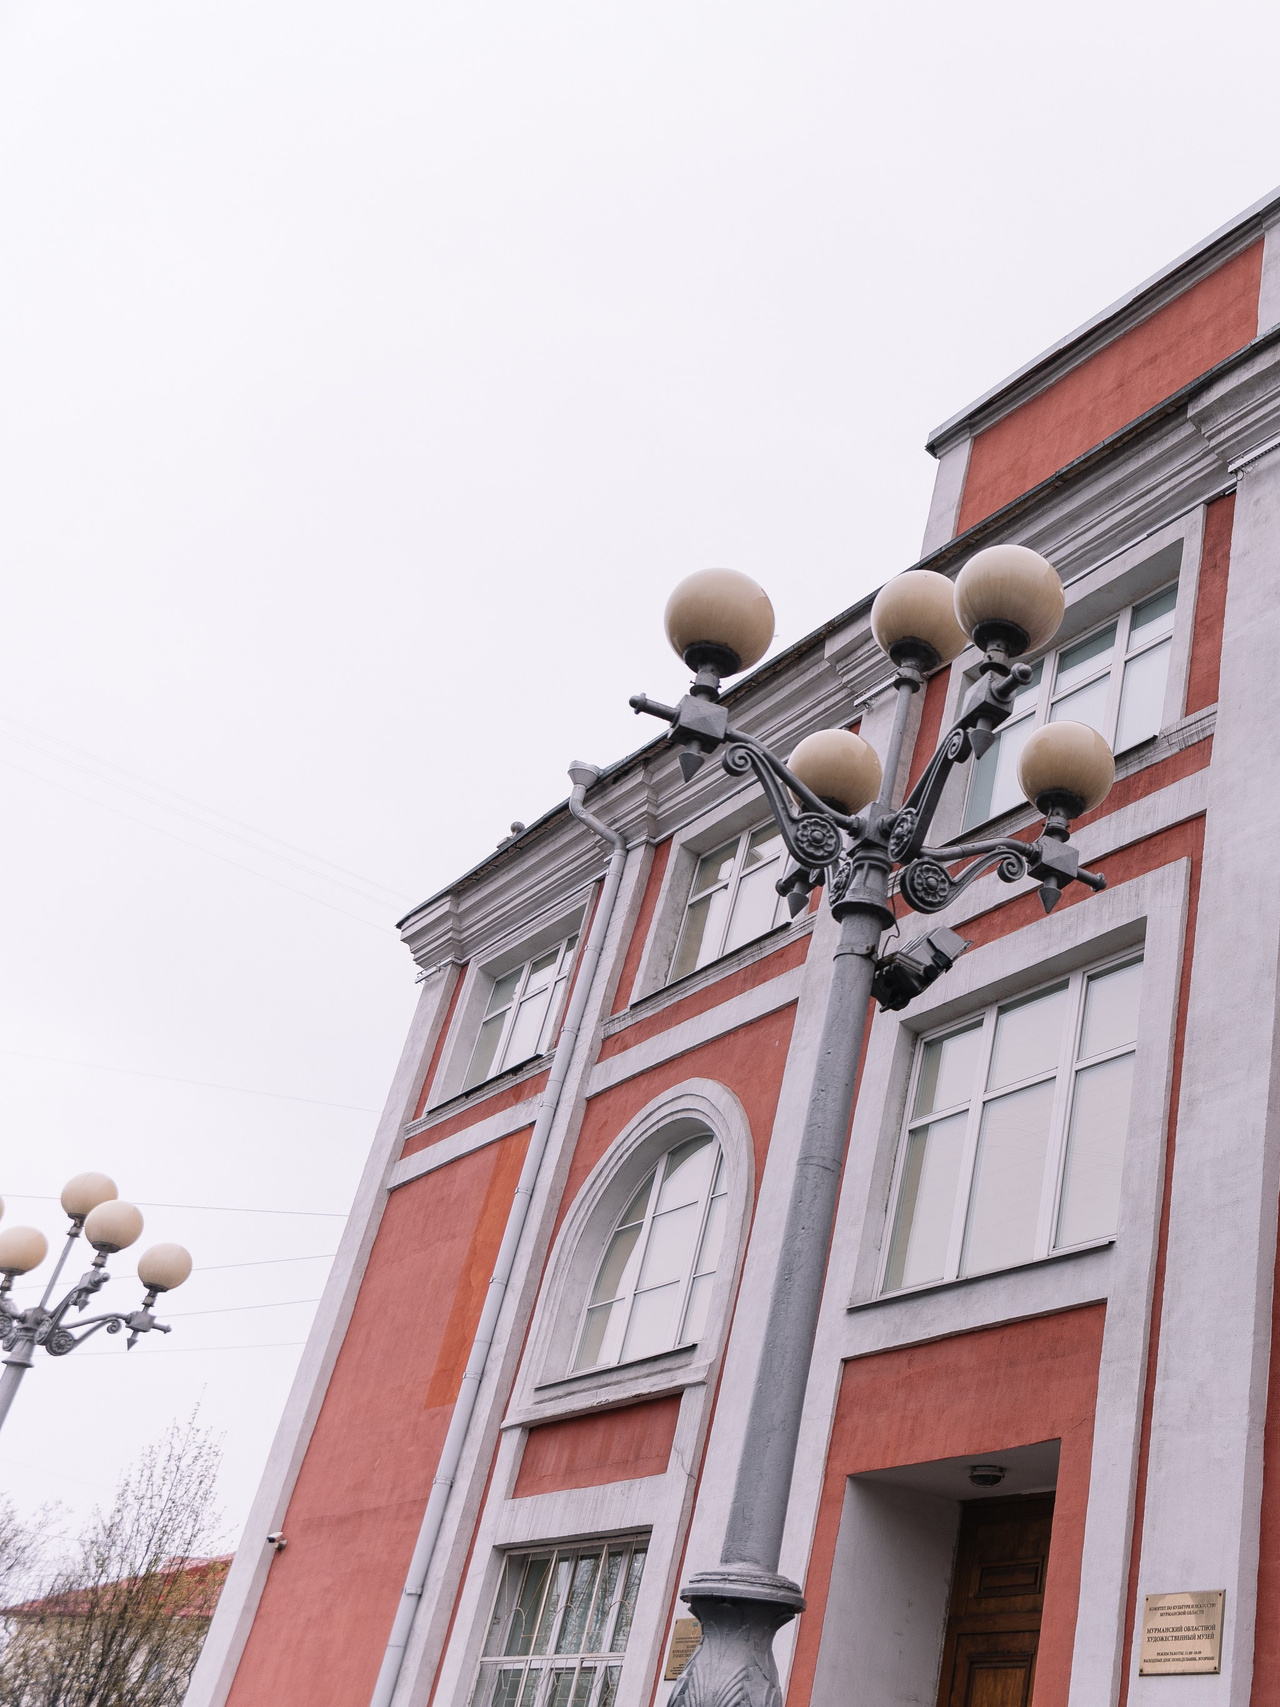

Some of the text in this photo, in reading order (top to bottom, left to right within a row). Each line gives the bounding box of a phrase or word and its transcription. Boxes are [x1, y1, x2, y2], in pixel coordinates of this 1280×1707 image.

[1147, 1623, 1216, 1634] МУРМАНСКИЙ ОБЛАСТНОЙ
[1147, 1632, 1215, 1643] ХУДОЖЕСТВЕННЫЙ МУЗЕЙ
